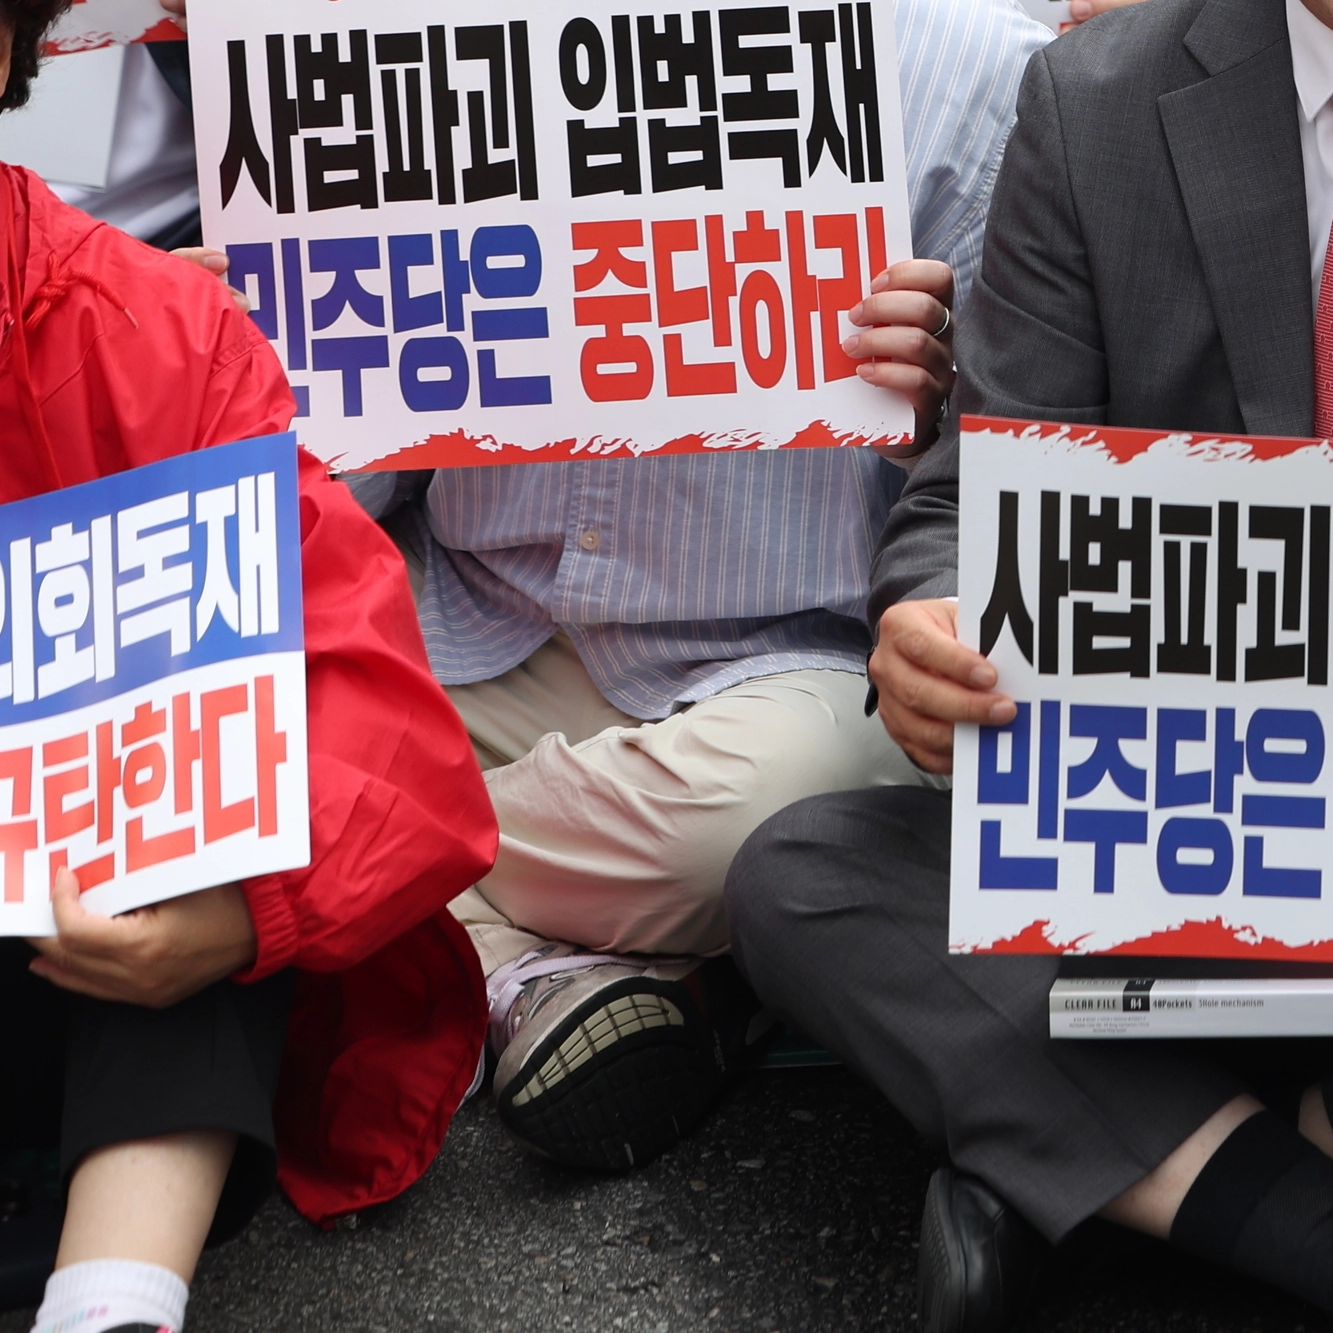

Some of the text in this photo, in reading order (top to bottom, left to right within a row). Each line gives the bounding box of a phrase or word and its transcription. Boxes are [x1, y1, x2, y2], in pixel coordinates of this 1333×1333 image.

[219, 2, 885, 215] 사법파괴 입법독재
[225, 206, 892, 418] 민주당은 중단하라
[979, 489, 1332, 687] 사법파괴
[976, 699, 1327, 899] 민주당은
[1064, 998, 1094, 1010] CLEAR
[1096, 998, 1117, 1010] FILE
[1129, 997, 1143, 1010] A4
